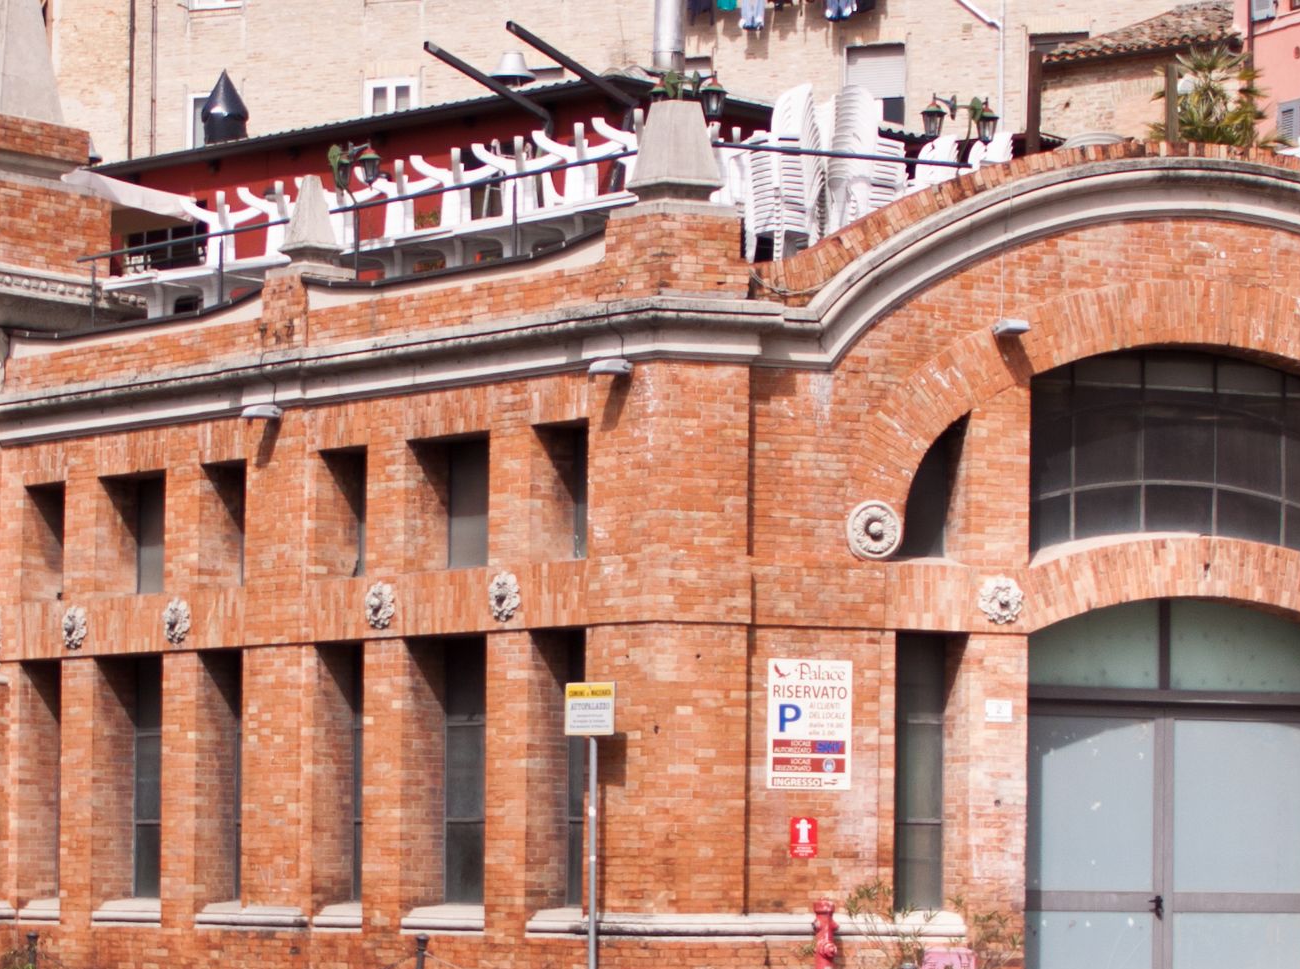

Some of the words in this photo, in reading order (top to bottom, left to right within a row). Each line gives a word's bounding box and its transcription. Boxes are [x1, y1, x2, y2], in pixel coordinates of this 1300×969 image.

[773, 684, 848, 700] RISERVATO
[816, 702, 840, 710] CLIENTI
[779, 703, 803, 733] P
[808, 711, 820, 719] DEL
[822, 711, 846, 720] LOCALE
[790, 757, 812, 765] LOCALE
[773, 765, 812, 773] SELEZIONATO
[773, 777, 821, 787] INGRESSO
